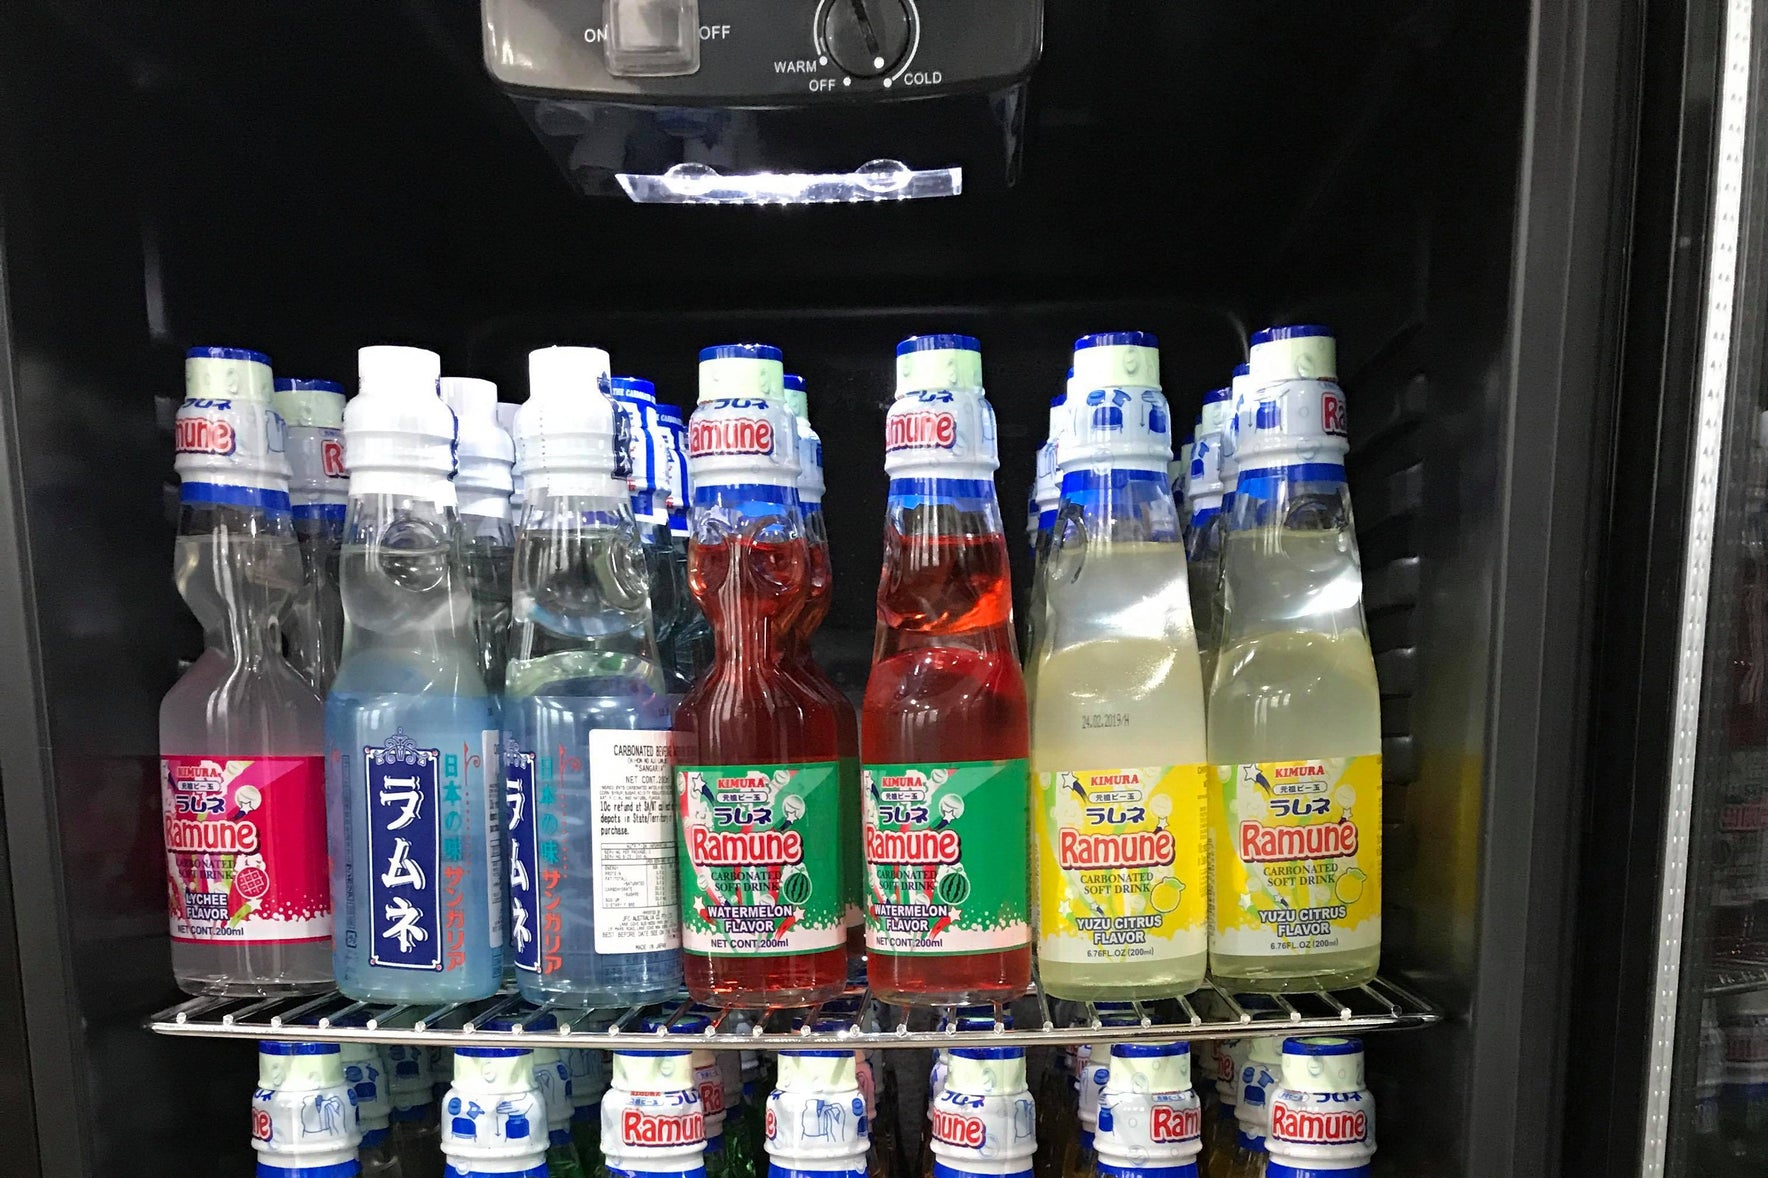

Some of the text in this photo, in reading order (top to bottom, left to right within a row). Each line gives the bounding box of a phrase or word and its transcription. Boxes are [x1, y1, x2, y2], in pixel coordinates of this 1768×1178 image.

[584, 24, 608, 42] ON
[700, 25, 730, 40] OFF
[774, 60, 817, 73] WARM
[904, 72, 942, 85] COLD
[809, 79, 836, 91] OFF
[175, 419, 234, 454] mune
[886, 413, 956, 448] mune
[614, 745, 653, 756] CARBONATED
[178, 767, 217, 777] KIMURA
[1275, 766, 1324, 778] KIMURA
[718, 778, 765, 789] KIMURA
[882, 777, 922, 787] KIMURA
[1091, 774, 1139, 786] KIMURA
[614, 801, 633, 811] refund
[600, 814, 620, 824] depots
[165, 814, 257, 850] Ramune
[692, 826, 801, 862] Ramune
[866, 826, 957, 861] Ramune
[1241, 822, 1357, 859] Ramune
[1061, 829, 1174, 867] Ramune
[380, 775, 428, 953] ラムネ
[1264, 864, 1338, 876] CARBONATED
[711, 871, 781, 881] CARBONATED
[877, 870, 937, 880] CARBONATED
[1080, 873, 1153, 884] CARBONATED
[1268, 876, 1335, 886] SOFT DRINK
[744, 882, 779, 891] DRINK
[902, 881, 934, 890] DRINK
[1084, 884, 1150, 894] SOFT DRINK
[185, 893, 227, 905] LYCHEE
[186, 908, 229, 920] FLAVOR
[708, 905, 792, 917] WATERMELON
[875, 905, 947, 916] WATERMELON
[1259, 906, 1346, 923] YUZU CITRUS
[725, 921, 774, 932] FLAVOR
[886, 919, 928, 931] FLAVOR
[1077, 915, 1162, 930] YUZU CITRUS
[1278, 922, 1330, 937] FLAVOR
[876, 937, 888, 946] NET
[1093, 930, 1145, 944] FLAVOR
[711, 939, 727, 948] NET
[622, 1107, 707, 1147] Ramun
[1151, 1105, 1200, 1141] Ram
[1271, 1101, 1368, 1143] Ramune
[932, 1110, 986, 1148] mune
